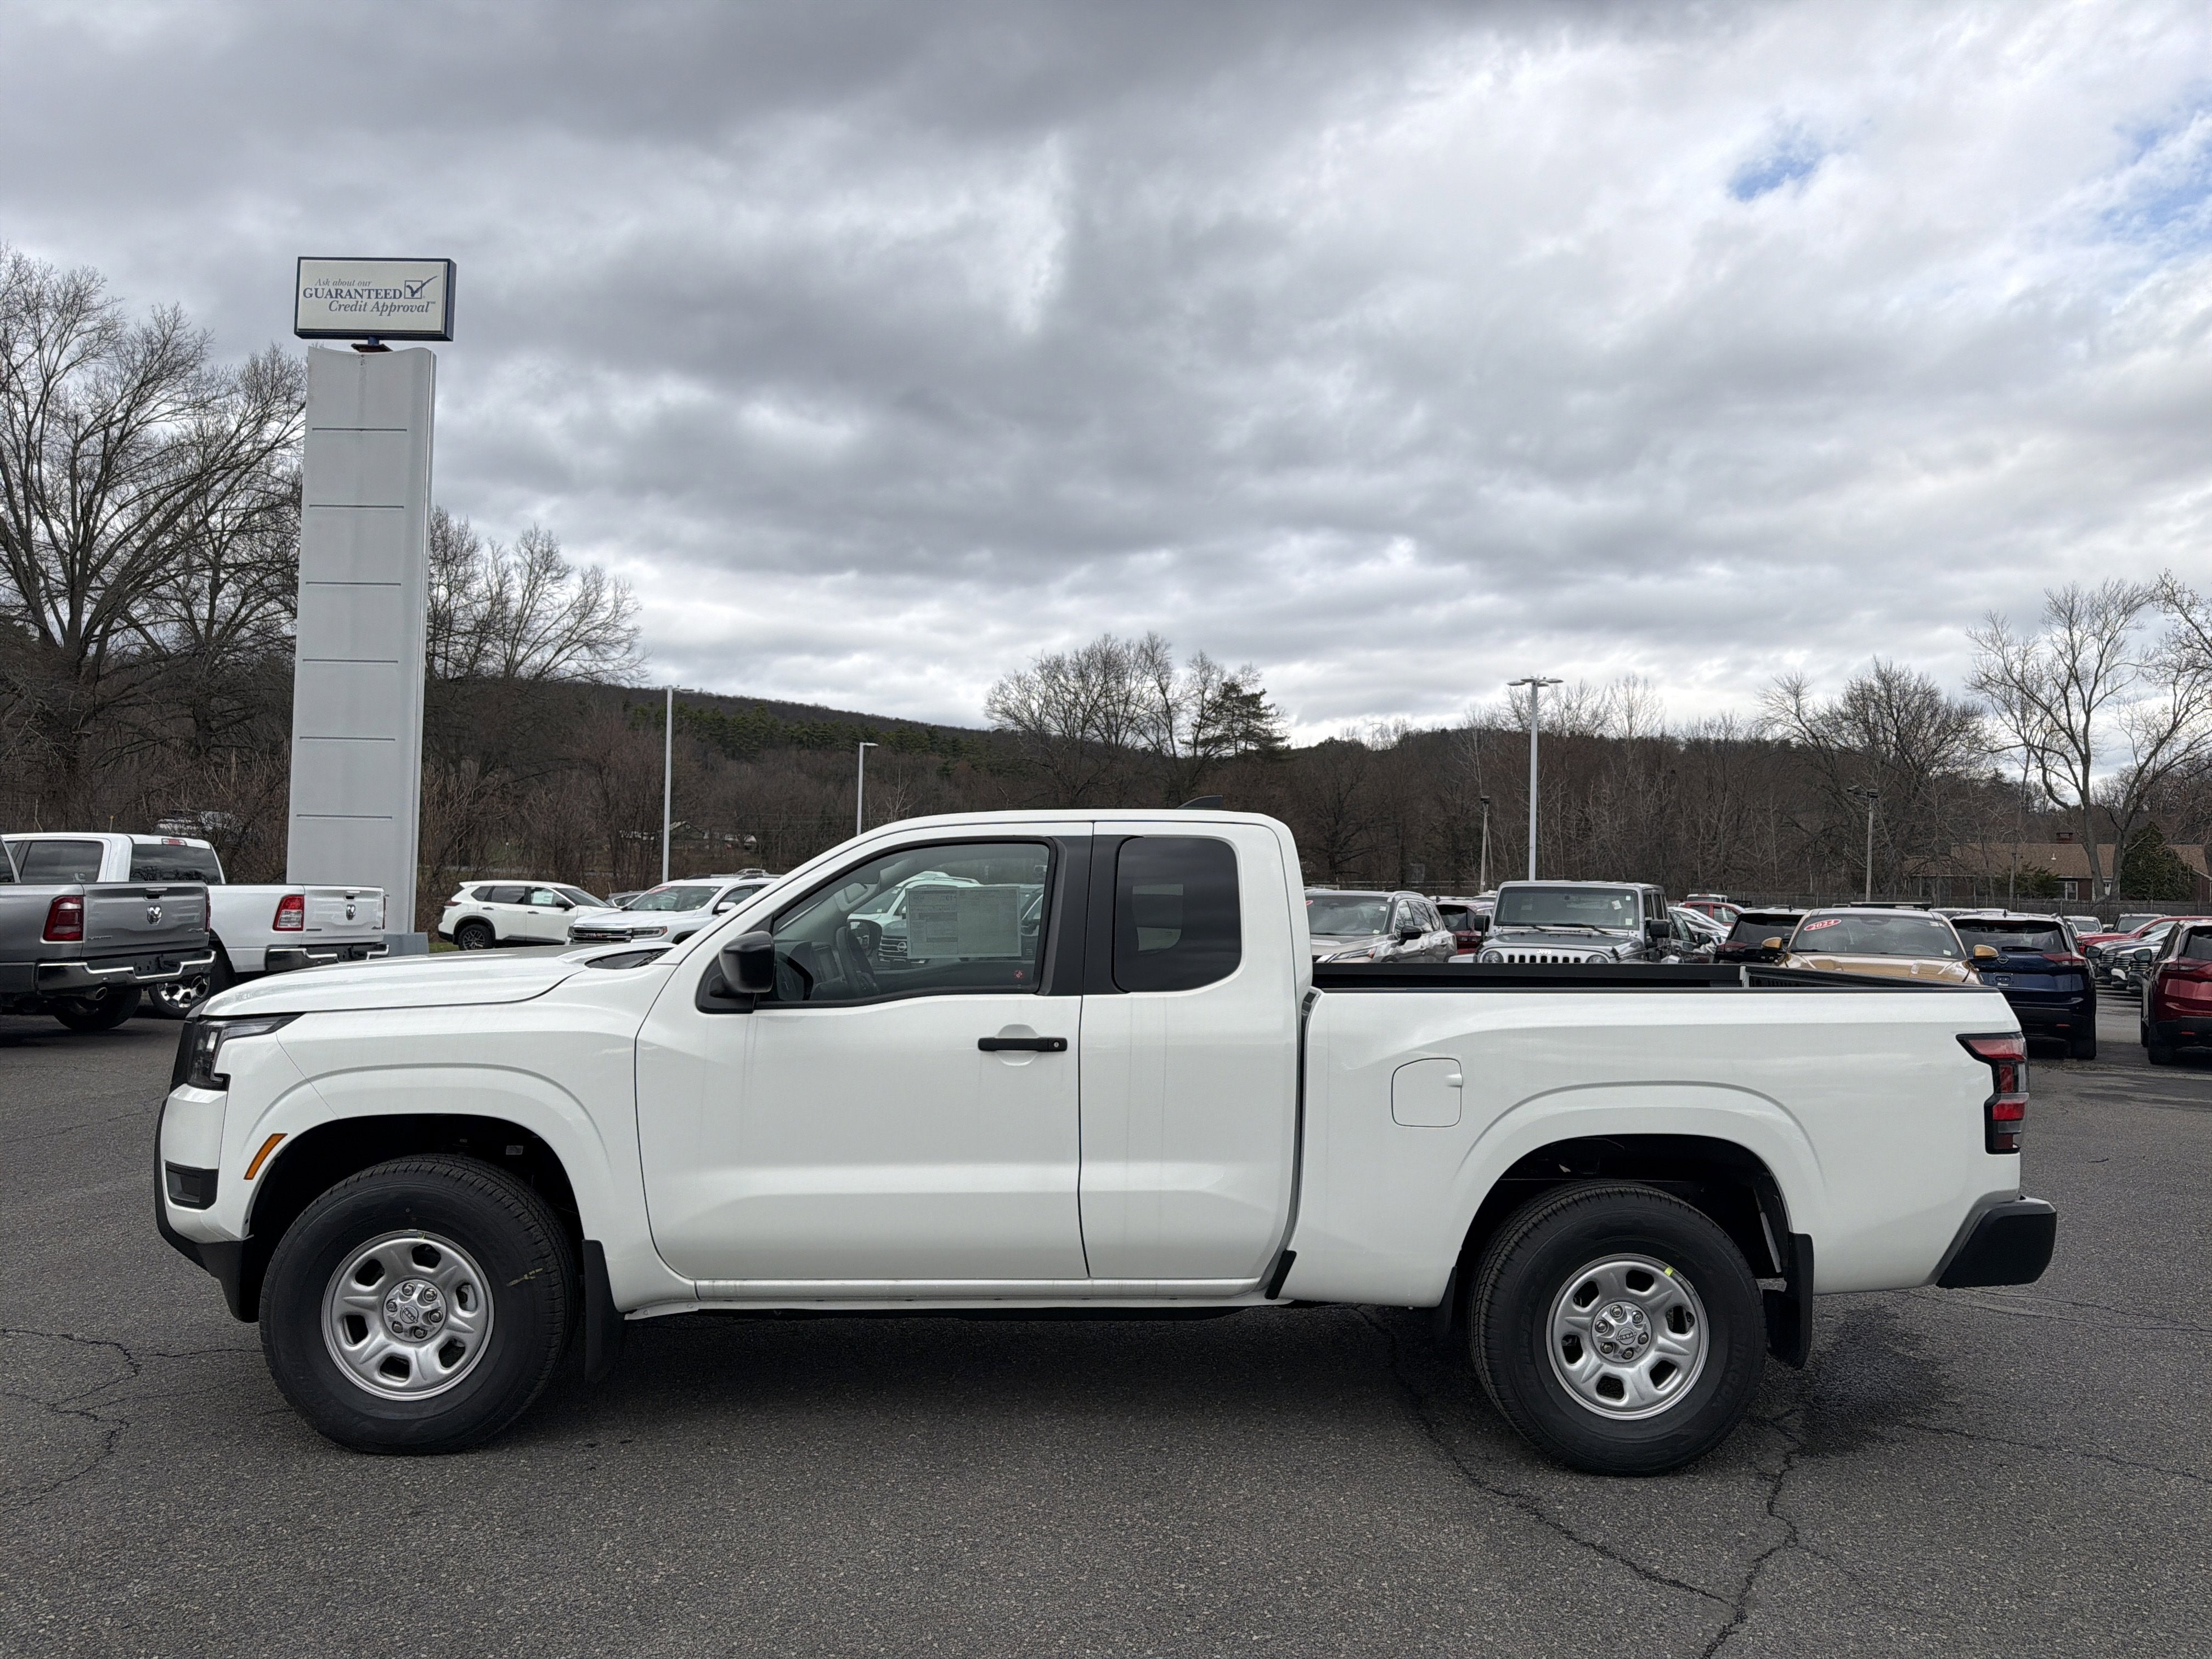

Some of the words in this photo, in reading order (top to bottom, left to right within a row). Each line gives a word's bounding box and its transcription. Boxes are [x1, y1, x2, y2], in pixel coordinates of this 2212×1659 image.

[315, 278, 330, 286] Ask
[332, 278, 356, 286] about
[303, 287, 403, 299] GUARANTEED
[329, 300, 368, 312] Credit
[369, 301, 430, 317] Approval
[1616, 1331, 1638, 1341] NISSAN
